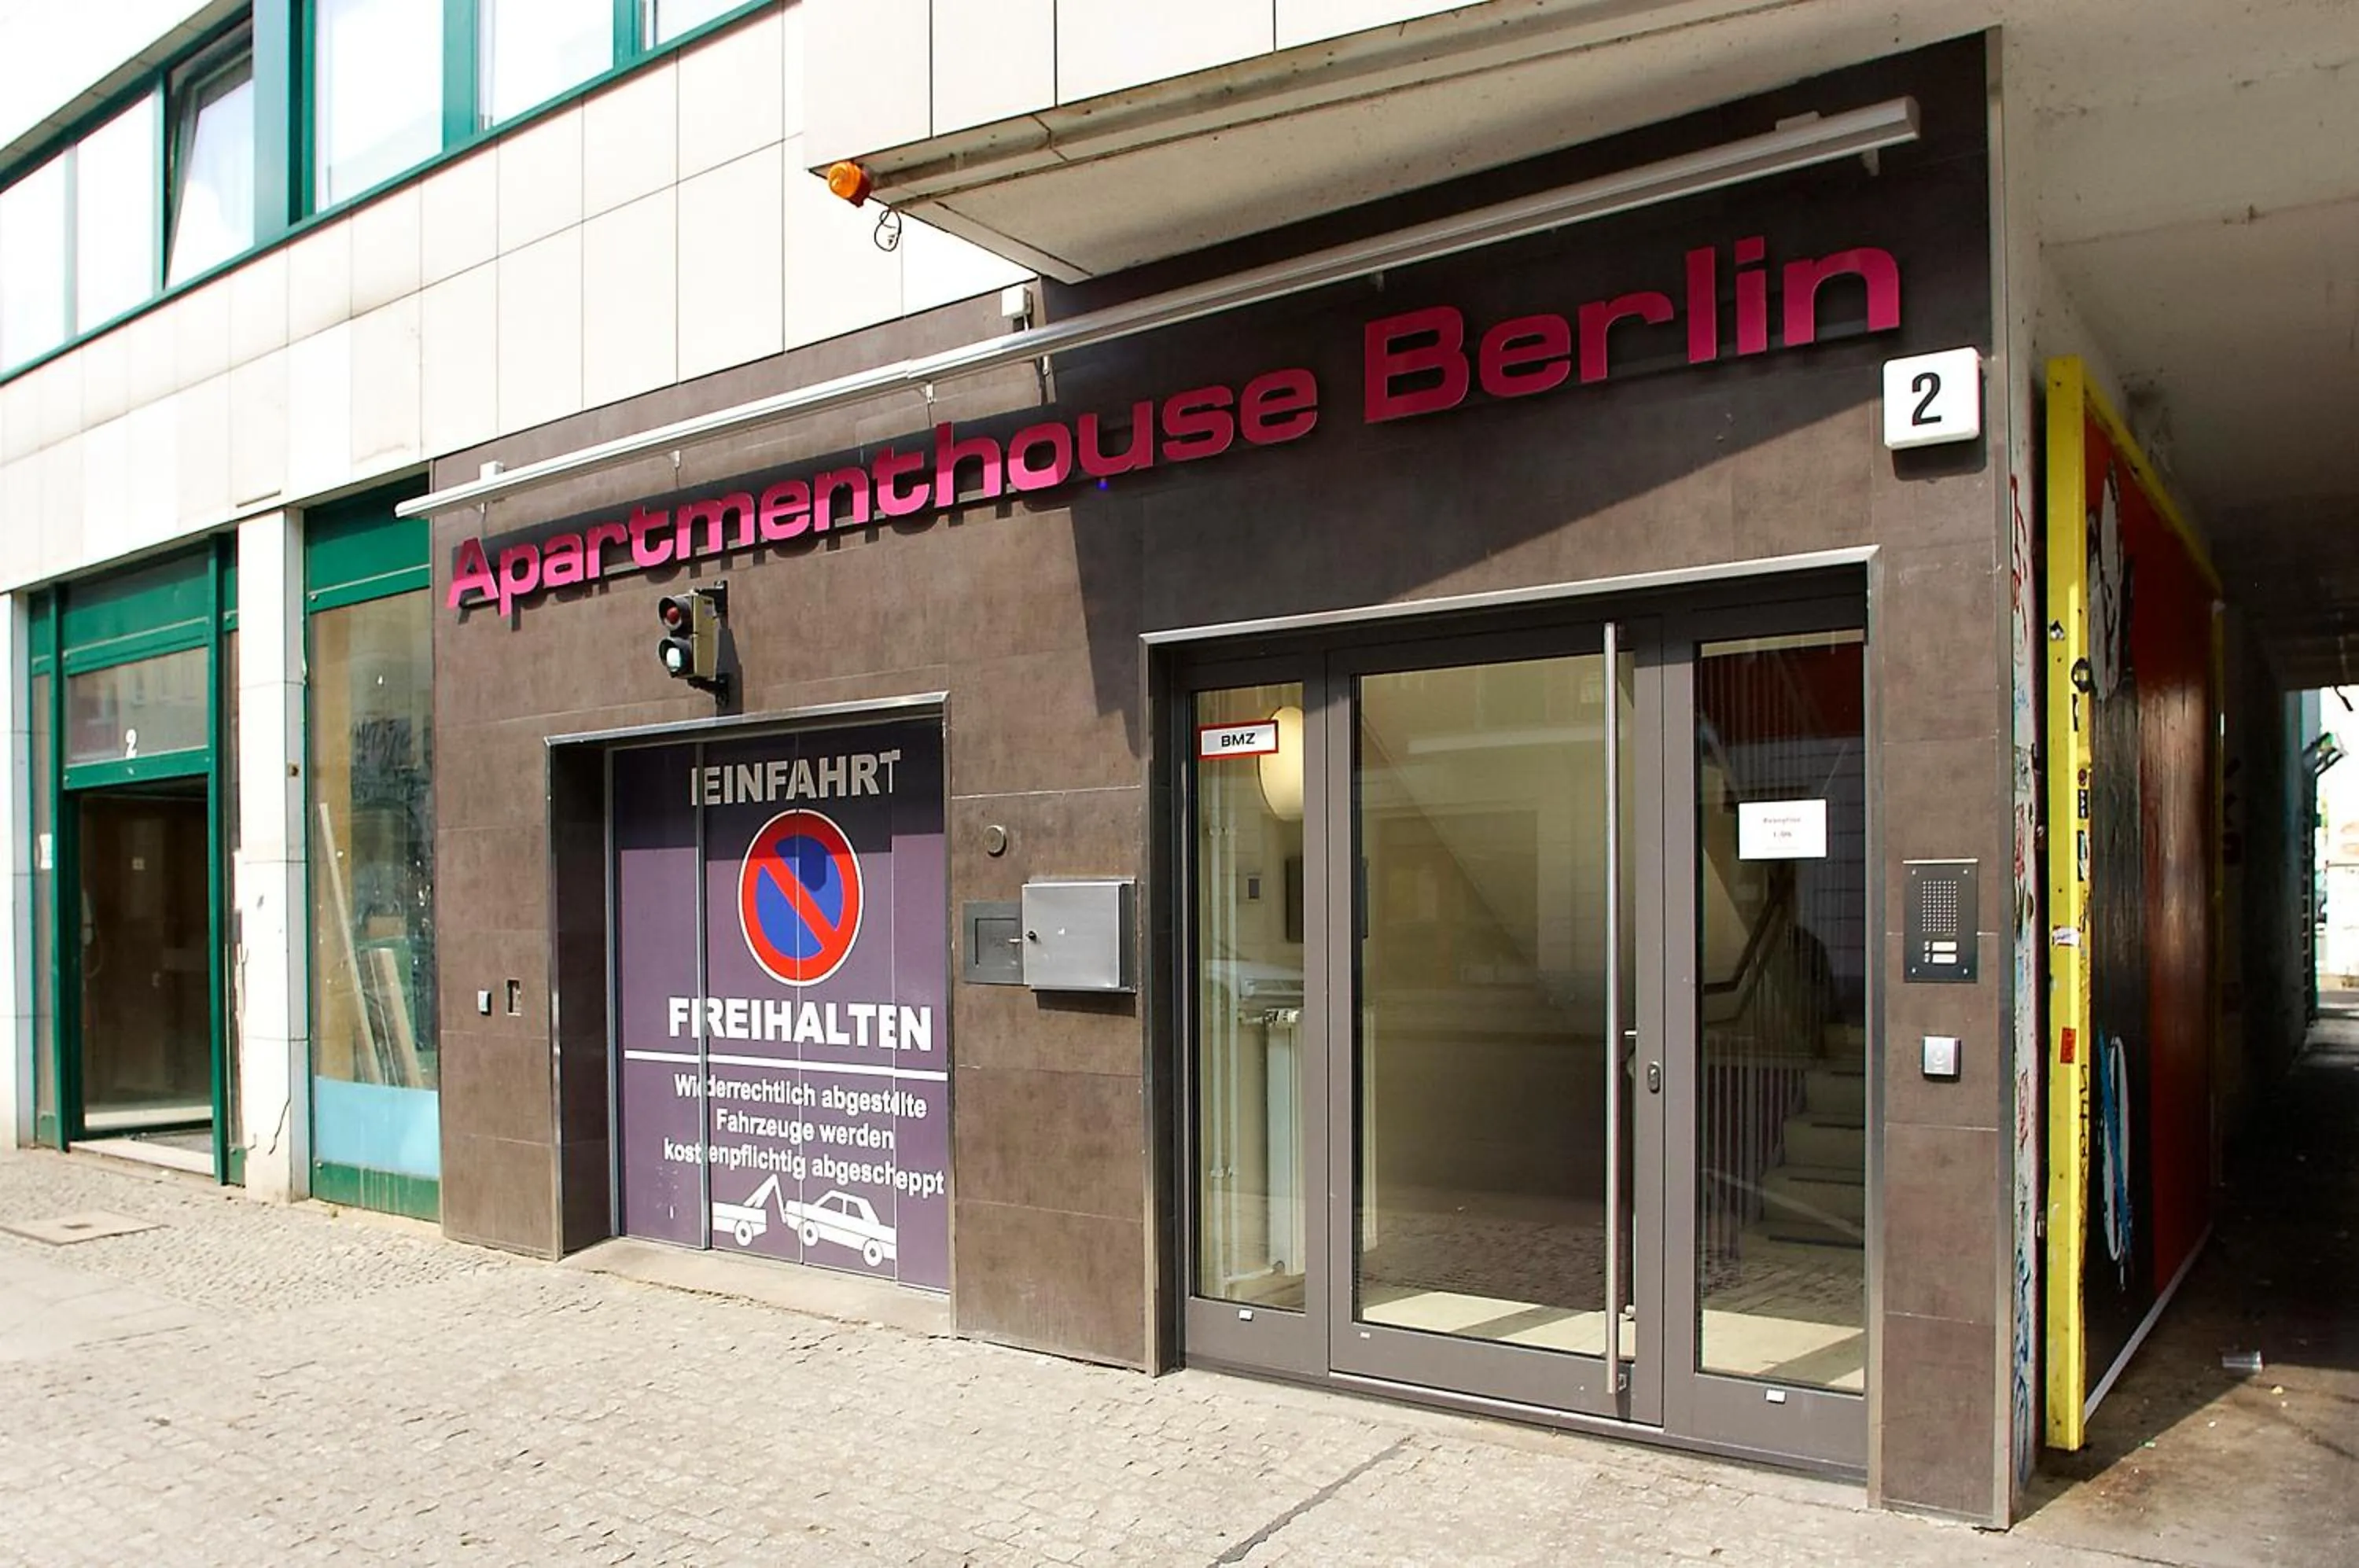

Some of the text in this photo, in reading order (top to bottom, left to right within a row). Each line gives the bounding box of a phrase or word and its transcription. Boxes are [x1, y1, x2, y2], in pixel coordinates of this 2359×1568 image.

[1912, 372, 1941, 426] 2
[446, 236, 1901, 618] Apartmenthouse Berlin
[125, 728, 138, 758] 2
[1221, 732, 1256, 747] BMZ
[691, 749, 901, 806] EINFAHRT
[668, 996, 932, 1051] FREIHALTEN
[674, 1073, 815, 1106] Widerrechtlich
[716, 1108, 894, 1149] Fahrzeuge werden
[664, 1137, 806, 1180] kostenpflichtig
